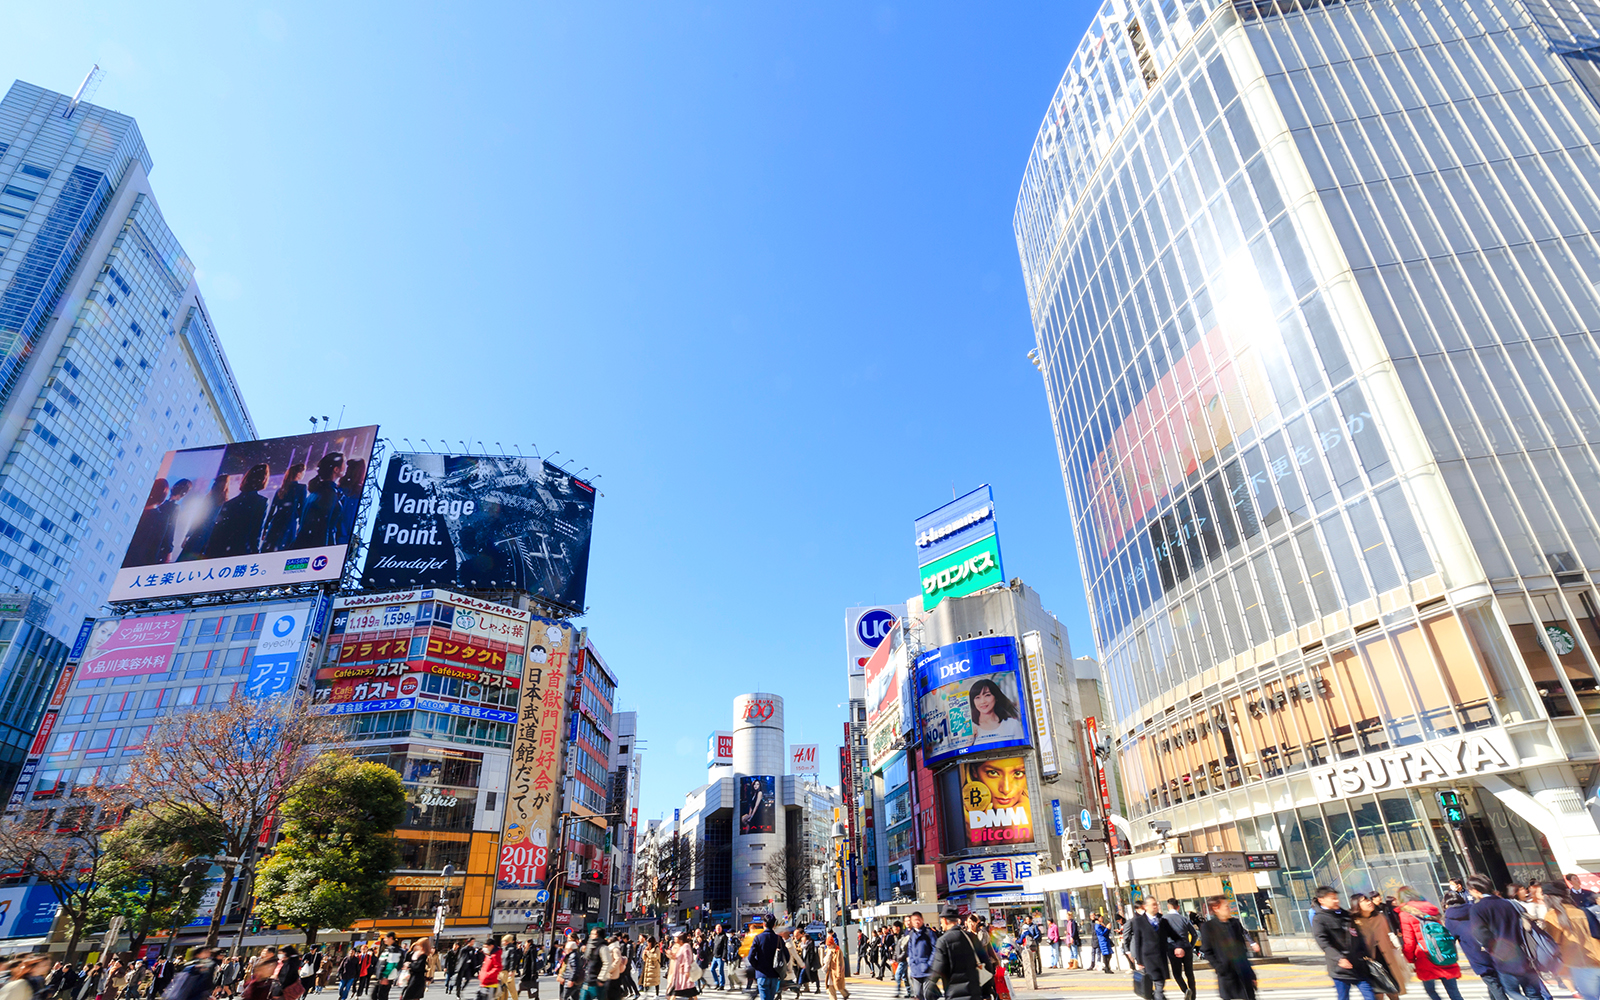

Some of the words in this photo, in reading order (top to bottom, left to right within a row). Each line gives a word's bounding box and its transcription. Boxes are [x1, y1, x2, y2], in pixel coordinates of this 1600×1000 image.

[398, 464, 424, 484] Go
[393, 493, 475, 520] Vantage
[383, 523, 443, 546] Point.
[915, 505, 990, 547] Hisamitsu
[373, 554, 449, 574] HondaJet
[922, 551, 995, 594] サロンパス
[129, 563, 267, 589] 人生楽しい人の勝ち。
[450, 593, 526, 619] しゃぶしゃぶバイキング
[132, 619, 179, 632] 品川スキン
[333, 617, 347, 627] 9F
[478, 616, 525, 638] しゃぶ葉
[130, 630, 171, 643] クリニック
[262, 637, 297, 650] eyecity
[342, 639, 407, 659] プライス
[427, 636, 504, 666] コンタクト
[92, 655, 166, 674] 品川美容外科
[375, 662, 410, 677] ガスト
[940, 658, 971, 679] DHC
[477, 672, 513, 688] ガスト
[315, 688, 332, 700] 7F
[351, 681, 396, 701] ガスト
[421, 700, 446, 709] AEON
[450, 704, 516, 722] 英会話イーオン
[741, 703, 775, 723] 109
[1034, 698, 1047, 736] neon
[511, 668, 543, 819] 日本武道館だって。
[720, 747, 733, 757] QL
[793, 747, 816, 763] H&M
[1311, 738, 1508, 799] TSUTAYA
[420, 794, 458, 808] Ushi8
[968, 806, 1029, 829] DMM
[971, 826, 1030, 843] Bitcoin
[500, 846, 547, 867] 2018
[503, 865, 538, 886] 3.11
[949, 860, 1033, 886] 大盛堂書店
